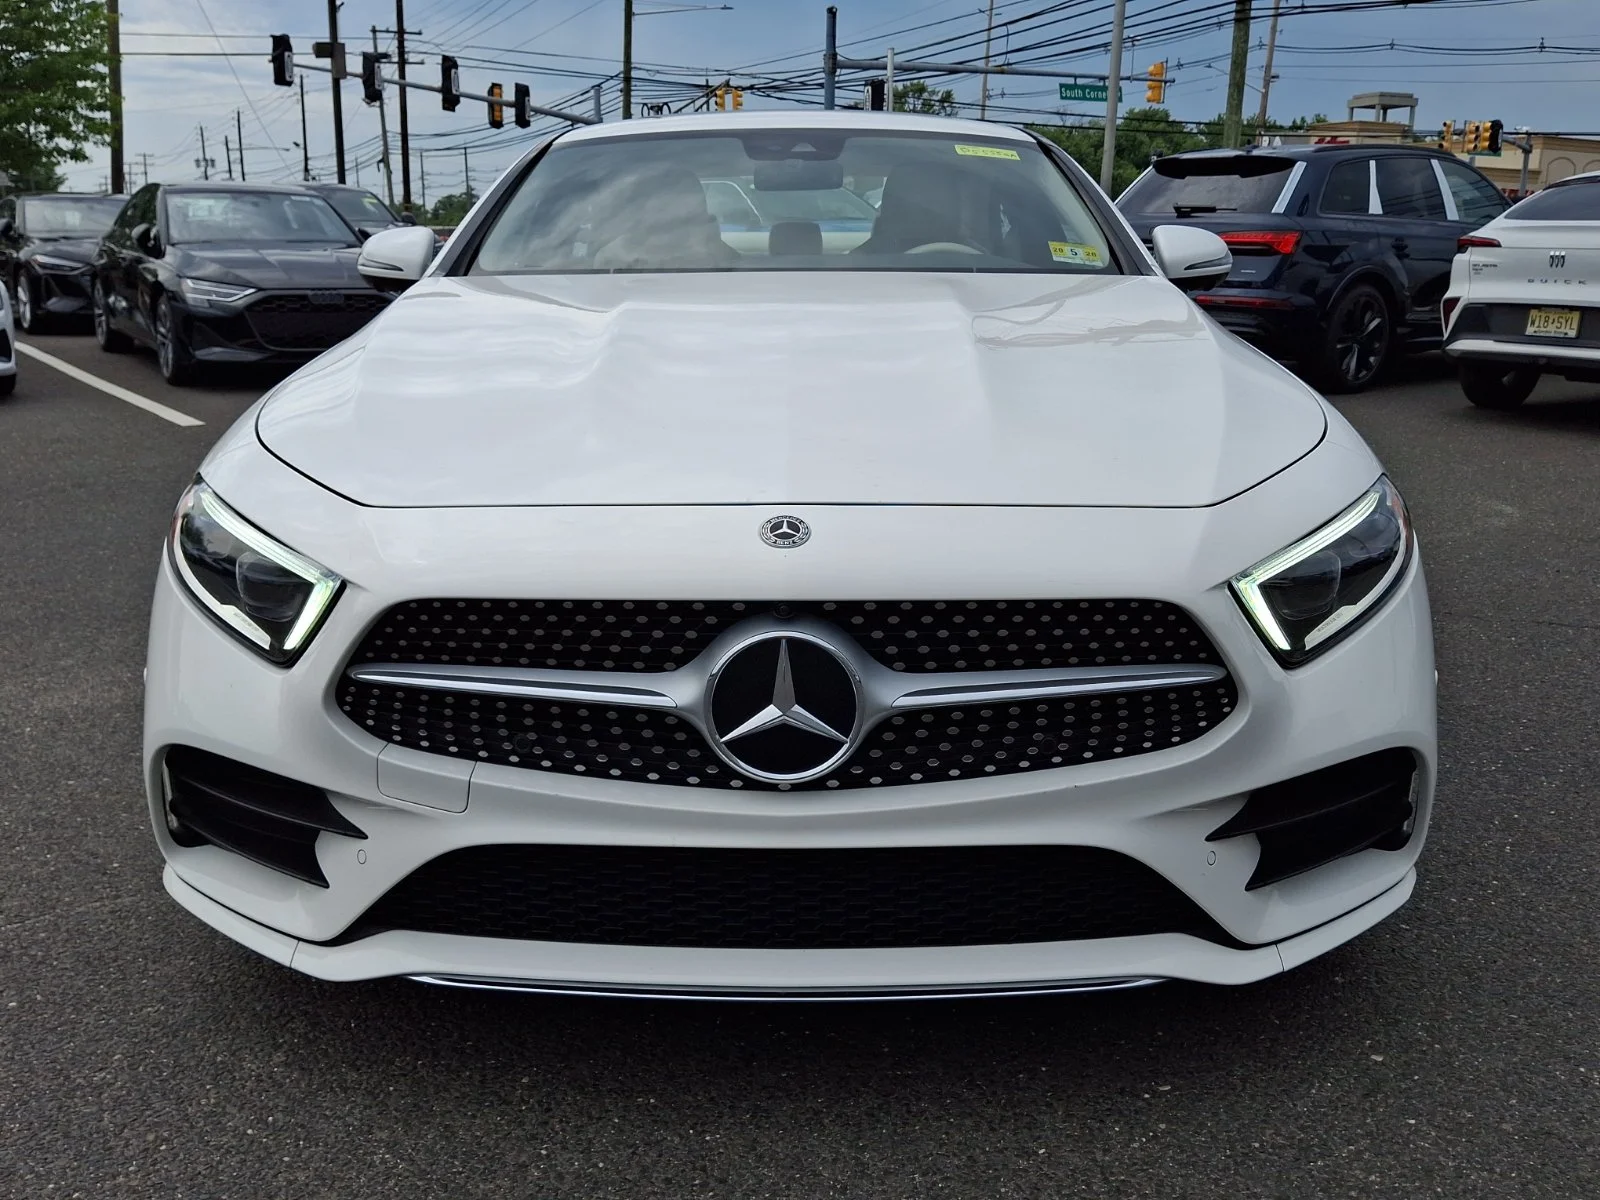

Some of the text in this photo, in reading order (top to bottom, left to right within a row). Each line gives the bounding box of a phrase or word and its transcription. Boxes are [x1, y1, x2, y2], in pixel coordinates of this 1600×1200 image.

[1061, 87, 1083, 98] South
[1085, 89, 1108, 100] Corne
[1070, 248, 1078, 256] 5
